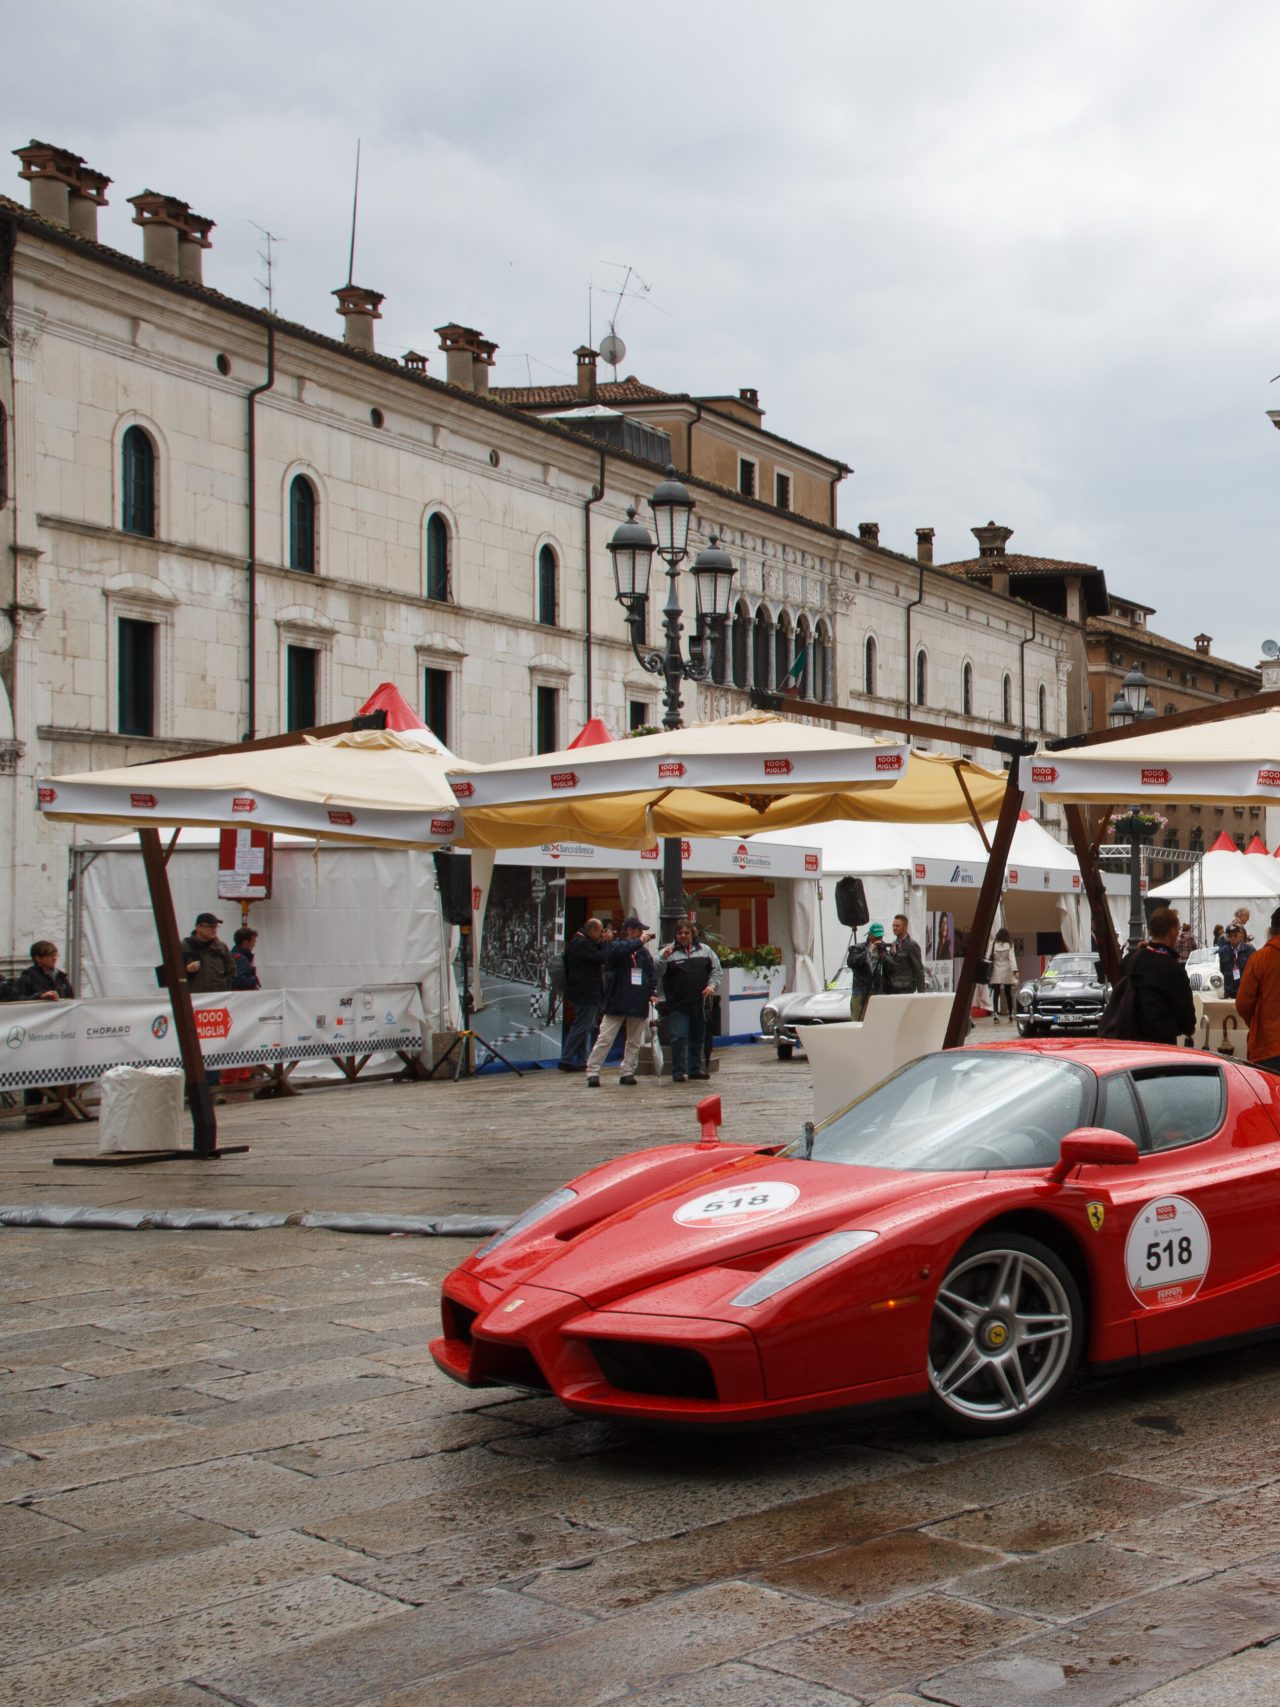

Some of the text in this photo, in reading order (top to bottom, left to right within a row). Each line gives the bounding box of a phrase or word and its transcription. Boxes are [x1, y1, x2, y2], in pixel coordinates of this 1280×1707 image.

[877, 763, 899, 771] MIGLIA
[1033, 767, 1052, 775] 1000
[1032, 774, 1052, 782] MIGLIA
[1259, 770, 1280, 778] 1000
[552, 780, 574, 788] MIGLIA
[1142, 776, 1165, 784] MIGLIA
[197, 1011, 223, 1022] 1000
[86, 1025, 131, 1036] CHOPARD
[28, 1031, 76, 1042] Mercedes-Benz
[703, 1194, 769, 1213] 518
[1146, 1236, 1192, 1271] 518
